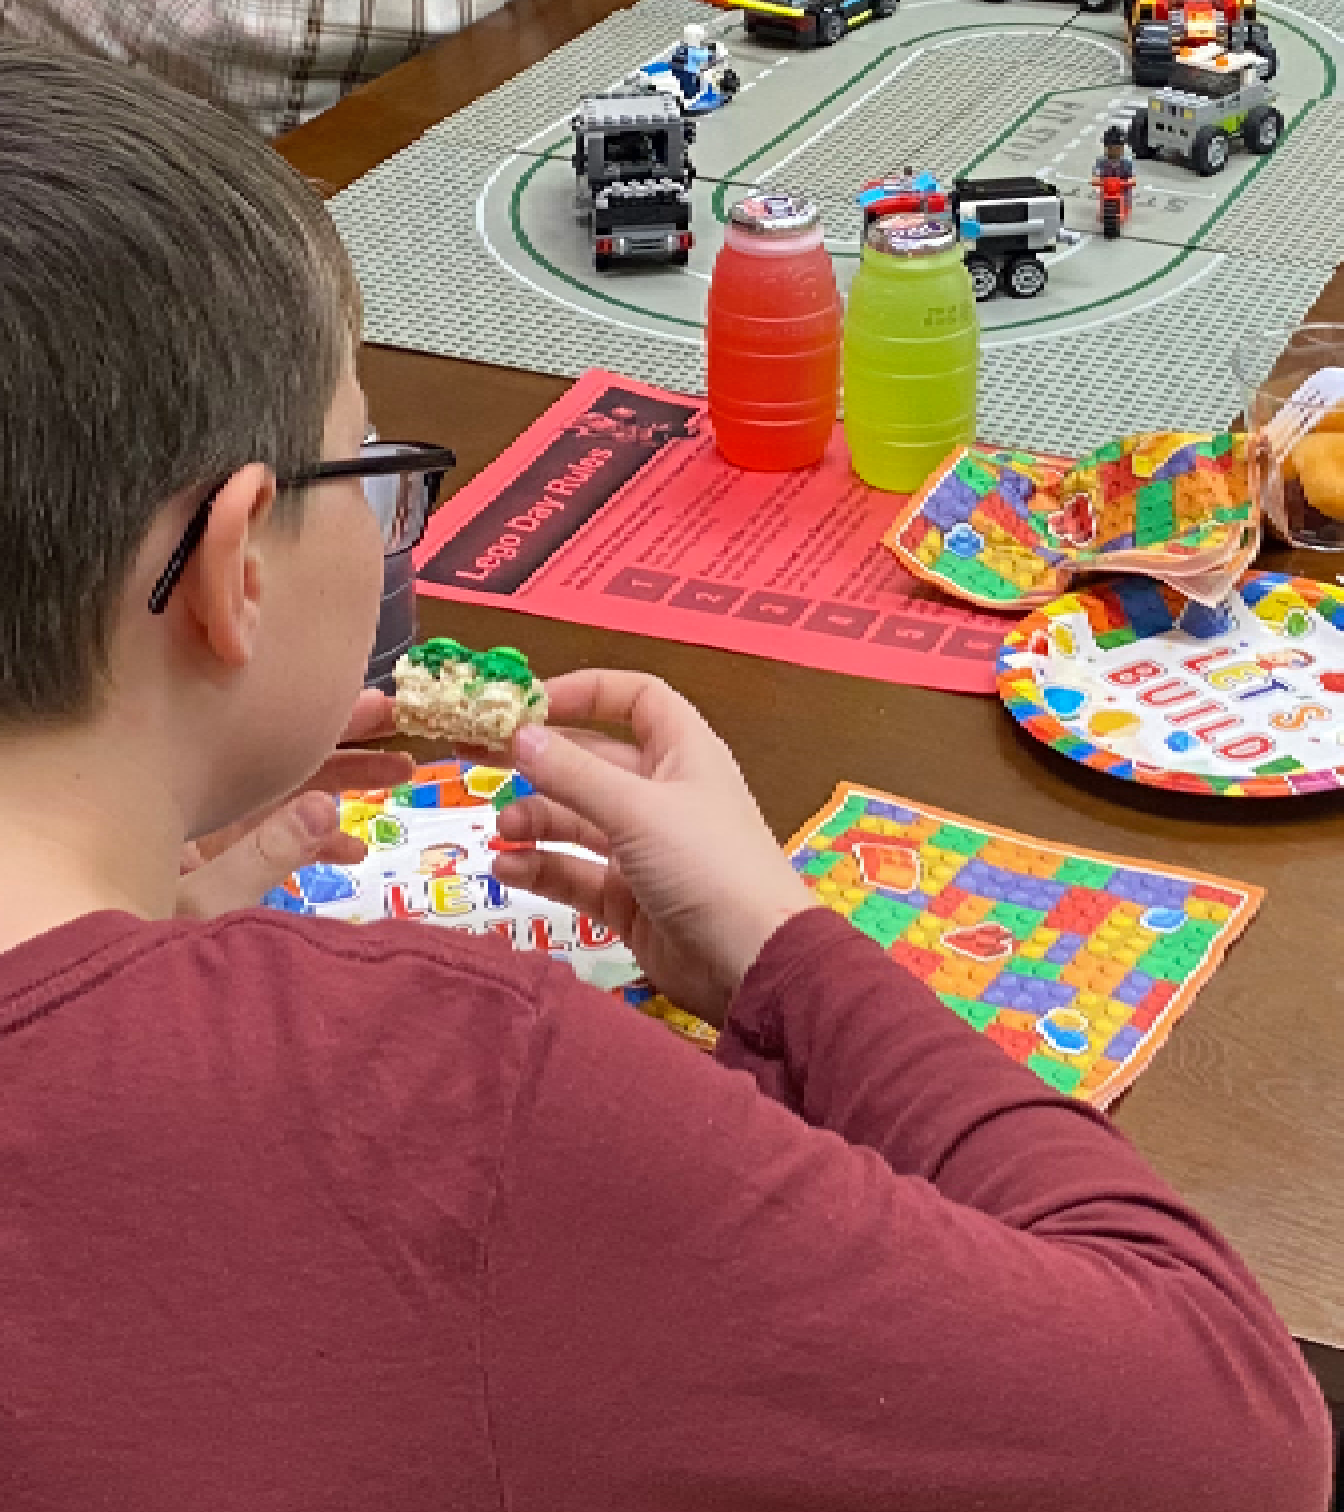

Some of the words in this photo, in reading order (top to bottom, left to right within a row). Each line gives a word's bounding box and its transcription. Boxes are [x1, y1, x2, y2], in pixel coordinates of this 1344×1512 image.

[456, 531, 521, 582] Lego
[504, 492, 566, 534] Day
[543, 445, 615, 497] Rules
[1102, 658, 1280, 765] BUILD
